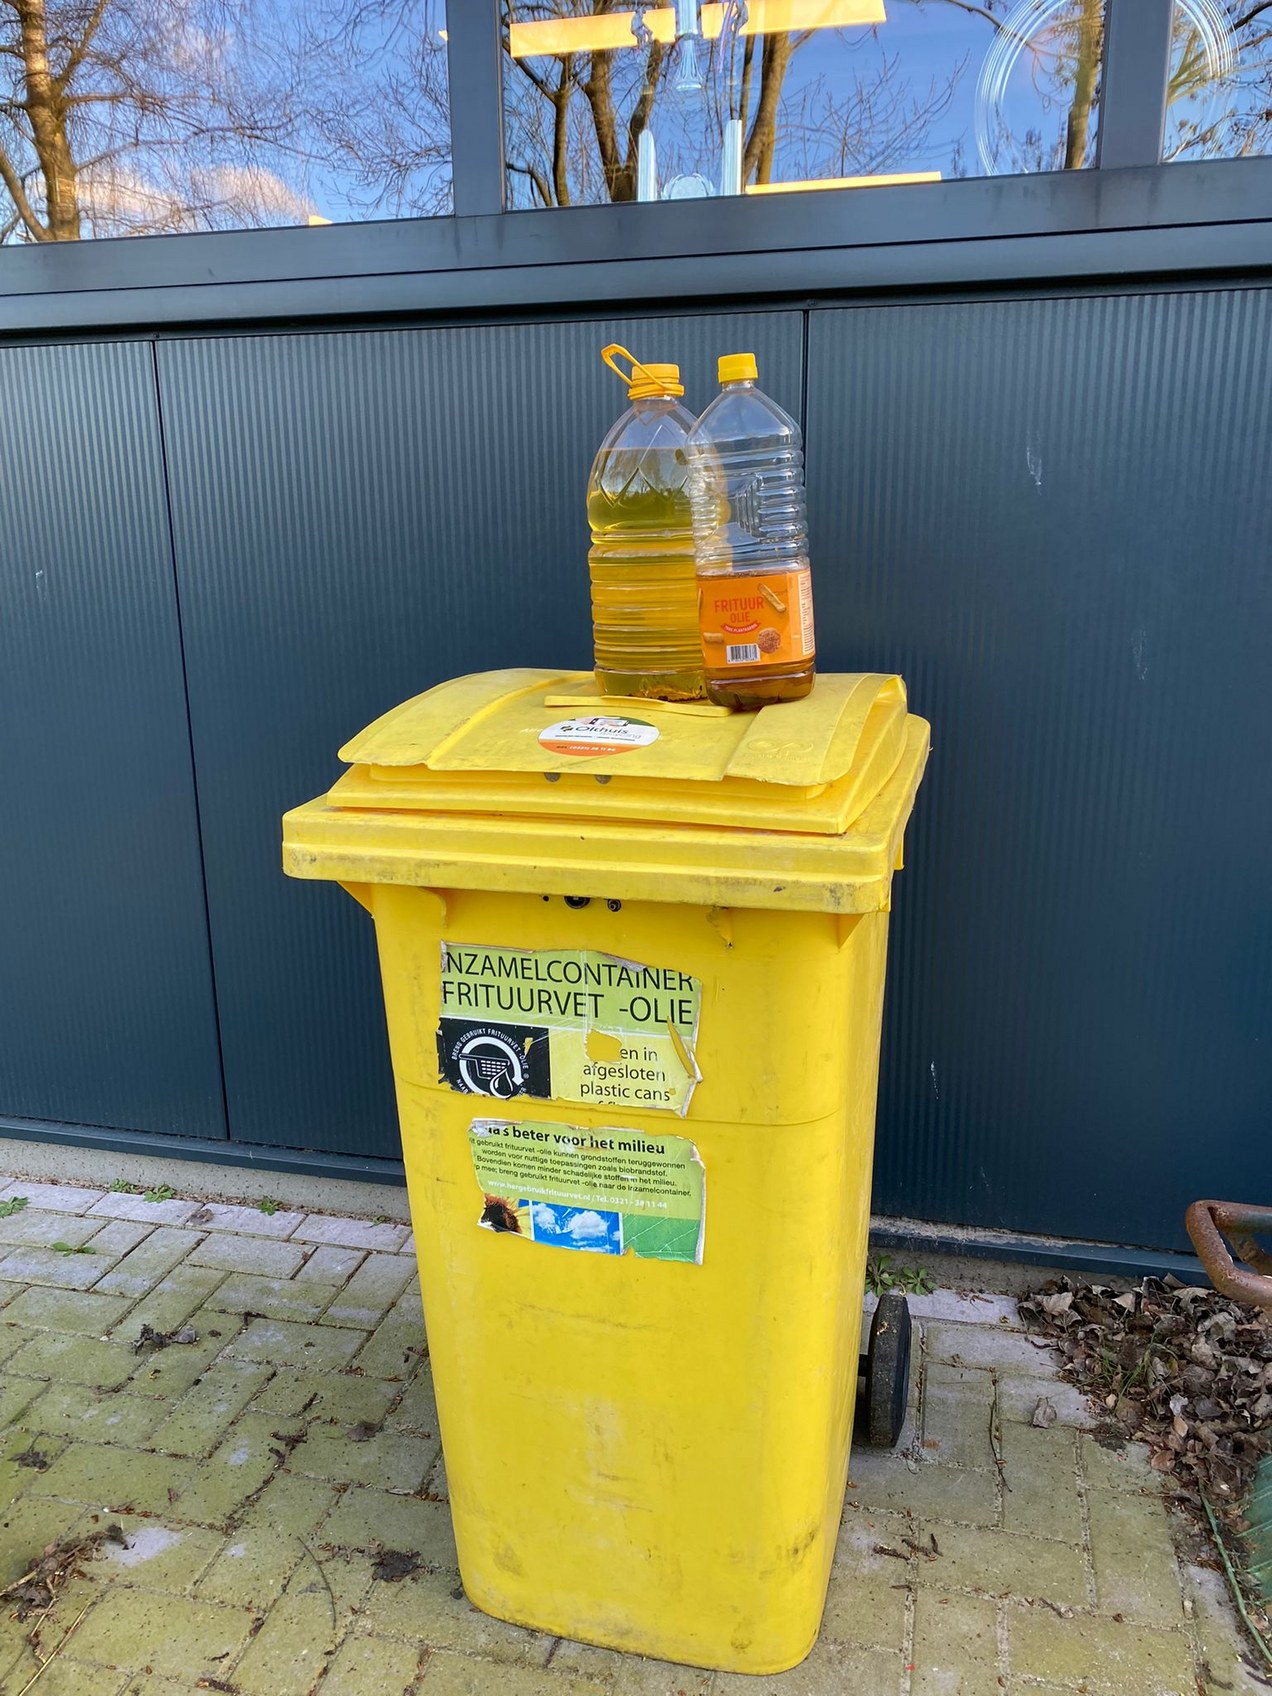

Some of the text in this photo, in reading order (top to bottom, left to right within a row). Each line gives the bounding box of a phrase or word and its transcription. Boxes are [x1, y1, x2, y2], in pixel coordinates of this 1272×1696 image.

[714, 597, 764, 613] FRITUUR
[730, 612, 751, 623] OLIE
[446, 952, 694, 992] NZAMELCONTAINER
[442, 981, 605, 1018] FRITUURVET
[460, 1028, 486, 1042] GEBRUIKT
[487, 1028, 521, 1052] FRITUURVET
[643, 1046, 658, 1061] in
[583, 1061, 666, 1081] afgesloten
[580, 1081, 671, 1101] plastic cans
[512, 1126, 550, 1143] beter
[553, 1134, 587, 1147] voor
[590, 1135, 615, 1150] het
[618, 1139, 665, 1154] milieu
[476, 1139, 504, 1149] gebruikt
[504, 1142, 536, 1153] frituurvet
[553, 1149, 580, 1159] kunnen
[580, 1153, 627, 1164] grondstoffen
[628, 1158, 686, 1169] teruggewonnen
[482, 1148, 507, 1158] worden
[524, 1154, 549, 1164] nuttige
[549, 1158, 597, 1170] toepassingen
[598, 1164, 618, 1172] zoals
[619, 1165, 668, 1177] biobrandstof.
[476, 1154, 512, 1167] Bovendien
[513, 1161, 536, 1170] komen
[537, 1165, 562, 1174] minder
[563, 1168, 603, 1179] schadelijke
[603, 1173, 629, 1182] stoffen
[639, 1176, 652, 1184] het
[498, 1167, 519, 1178] breng
[519, 1171, 548, 1181] gebruikt
[548, 1175, 581, 1186] frituurvet
[599, 1182, 615, 1190] naar
[616, 1183, 627, 1191] de
